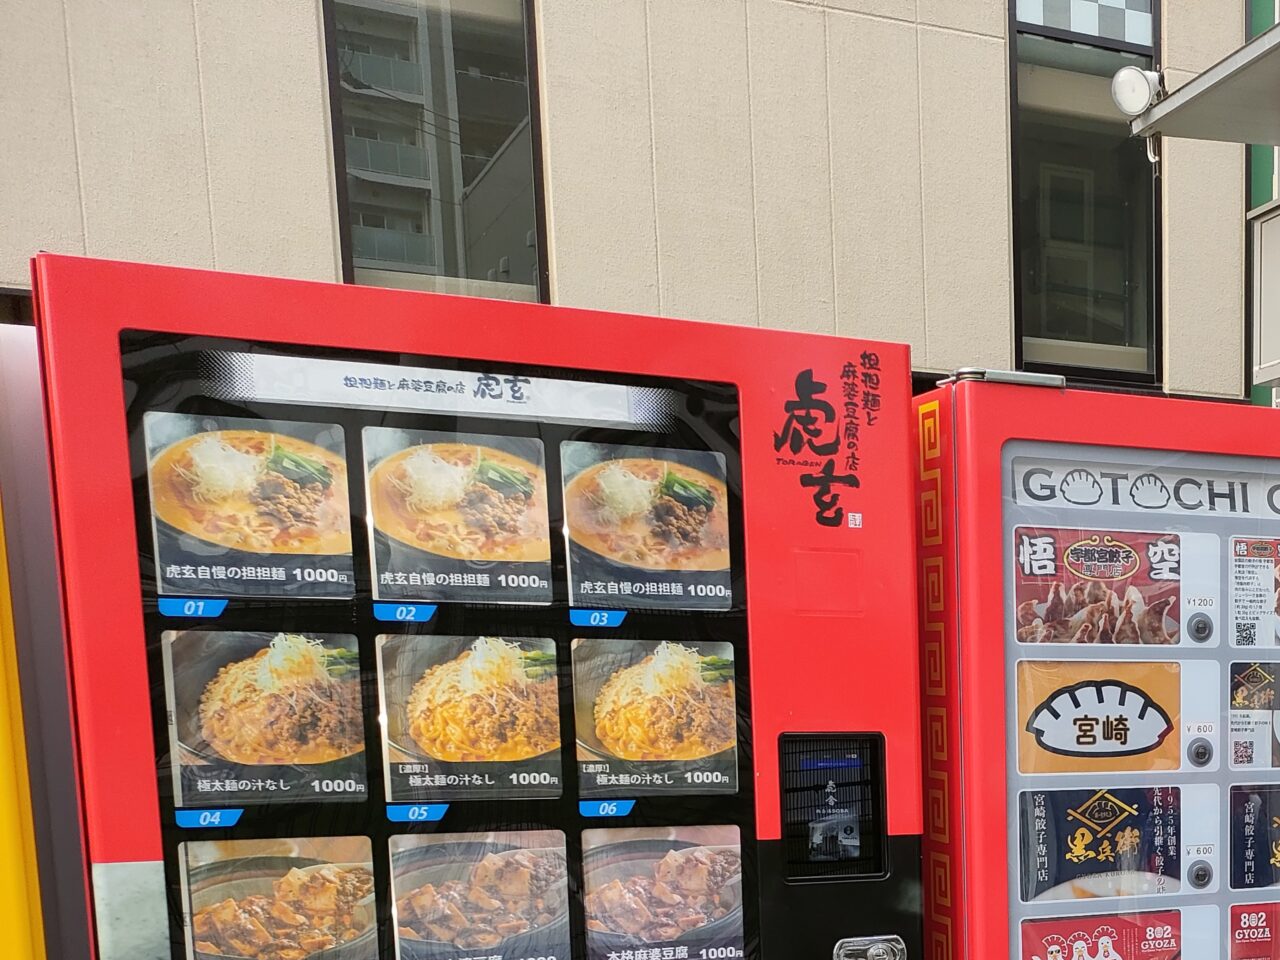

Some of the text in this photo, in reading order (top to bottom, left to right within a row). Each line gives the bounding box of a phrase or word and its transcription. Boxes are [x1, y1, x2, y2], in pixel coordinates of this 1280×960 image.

[472, 373, 531, 401] 虎玄
[773, 368, 860, 527] 虎玄
[165, 565, 348, 584] 虎玄自慢の担担麺 1000円
[380, 572, 548, 588] 虎玄自慢の担担麺 1000円
[580, 581, 683, 596] 虎玄自慢の担担麺
[183, 601, 205, 615] 01
[395, 606, 416, 620] 02
[590, 612, 609, 626] 03
[1072, 714, 1130, 745] 宮崎
[197, 778, 365, 793] 極太麺の汁なし 1000円
[408, 773, 559, 787] 極太麺の汁なし 1000円
[596, 772, 729, 785] 極太麺の汁なし 1000円
[408, 806, 428, 820] 05
[599, 802, 617, 815] 06
[199, 812, 221, 826] 04
[1033, 793, 1049, 882] 宮崎餃子専門店
[1240, 912, 1267, 927] 802
[1145, 925, 1172, 939] 802
[1235, 928, 1272, 939] GYOZA
[1140, 938, 1177, 949] GYOZA
[699, 947, 743, 959] 1000円
